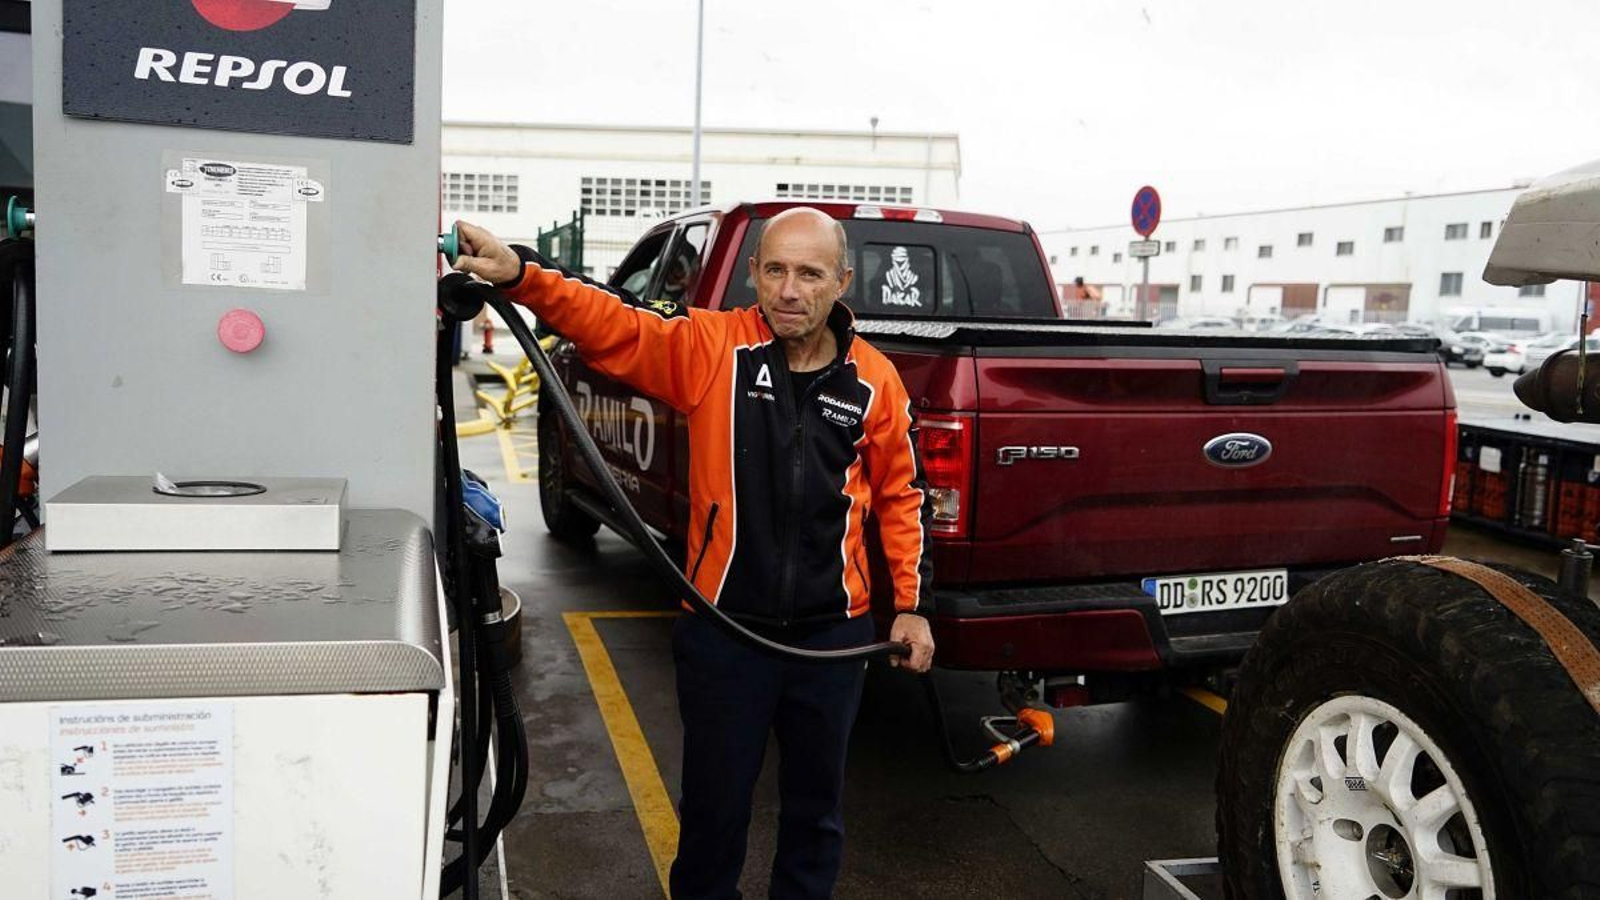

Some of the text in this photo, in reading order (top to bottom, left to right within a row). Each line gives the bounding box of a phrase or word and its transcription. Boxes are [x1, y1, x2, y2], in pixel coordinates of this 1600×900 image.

[134, 47, 352, 98] REPSOL
[881, 284, 923, 307] DAKAR
[817, 394, 863, 415] RODAMOTO
[1220, 440, 1257, 461] Ford
[1159, 575, 1284, 610] DD RS 9200
[118, 714, 130, 723] de
[101, 787, 109, 796] 2
[102, 830, 110, 840] 3
